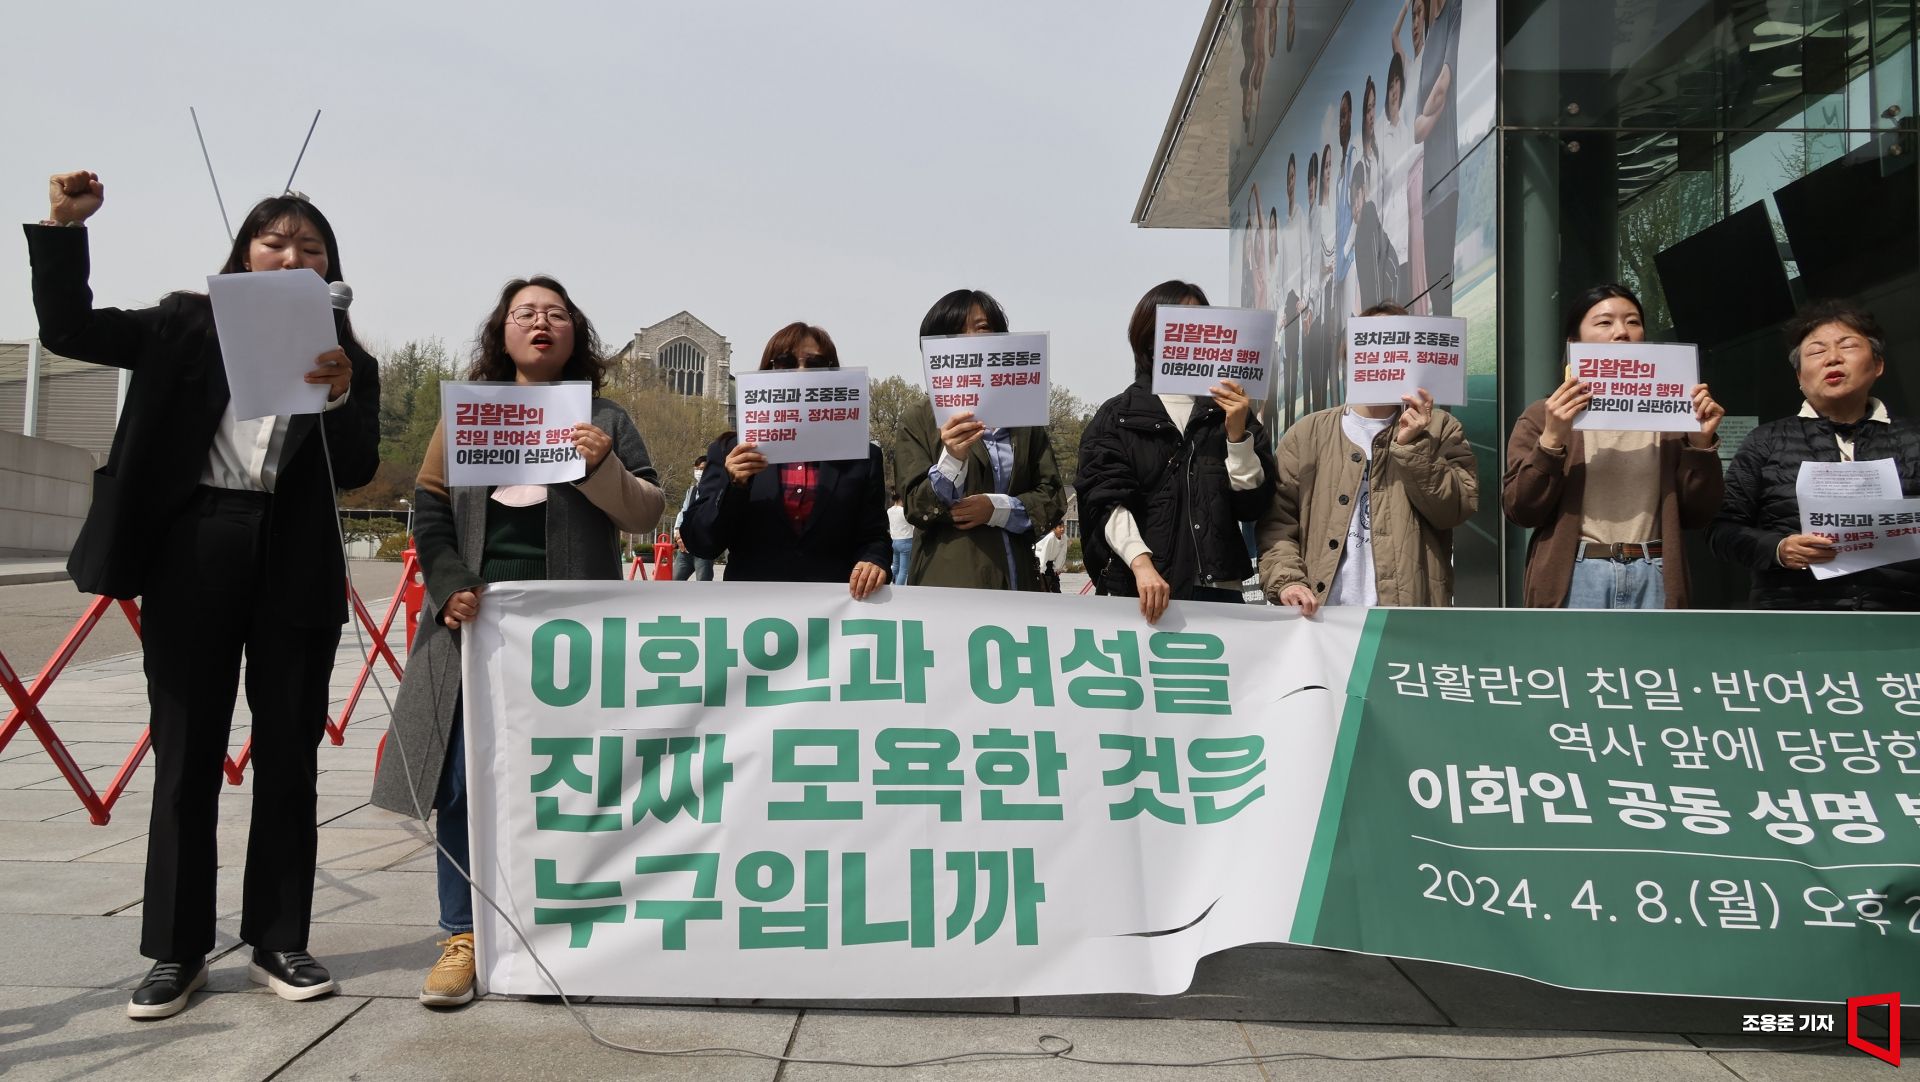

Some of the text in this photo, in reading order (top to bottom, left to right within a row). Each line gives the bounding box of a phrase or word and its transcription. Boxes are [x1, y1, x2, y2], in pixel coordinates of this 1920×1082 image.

[1164, 323, 1238, 344] 김활란의
[1354, 332, 1460, 347] 정치권과 조중동은
[930, 351, 1041, 369] 정치권과 조중동은
[1162, 346, 1260, 364] 친일 반여성 행위
[1354, 352, 1380, 364] 진실
[1417, 351, 1459, 366] 정치공세
[1161, 362, 1263, 381] 이화인이 심판하자
[1354, 369, 1405, 382] 중단하라
[1579, 359, 1655, 378] 김활란의
[932, 372, 1041, 389] 진실 왜곡, 정치공세
[744, 387, 860, 404] 정치권과 조중동은
[1611, 382, 1652, 396] 반여성
[1656, 383, 1684, 397] 행위
[935, 394, 979, 407] 중단하라
[1637, 399, 1692, 414] 심판하자
[456, 403, 544, 426] 김활란의
[745, 410, 770, 423] 진실
[808, 408, 860, 422] 정치공세
[456, 430, 488, 445] 친일
[493, 430, 541, 446] 반여성
[745, 428, 797, 442] 중단하라
[456, 448, 519, 464] 이화인이
[1809, 512, 1874, 527] 정치권과
[1886, 527, 1920, 538] 정치
[531, 615, 1232, 715] 이화인과 여성을
[1387, 661, 1570, 709] 김활란의
[1549, 722, 1647, 767] 역사
[1660, 725, 1764, 772] 앞에
[531, 727, 1266, 833] 진짜 모욕한 것은
[1408, 764, 1593, 824] 이화인
[1607, 779, 1732, 835] 공동
[1747, 789, 1885, 845] 성명
[534, 847, 1046, 951] 누구입니까
[1417, 863, 1552, 921] 2024.
[1570, 879, 1618, 922] 4.
[1803, 886, 1892, 935] 오후
